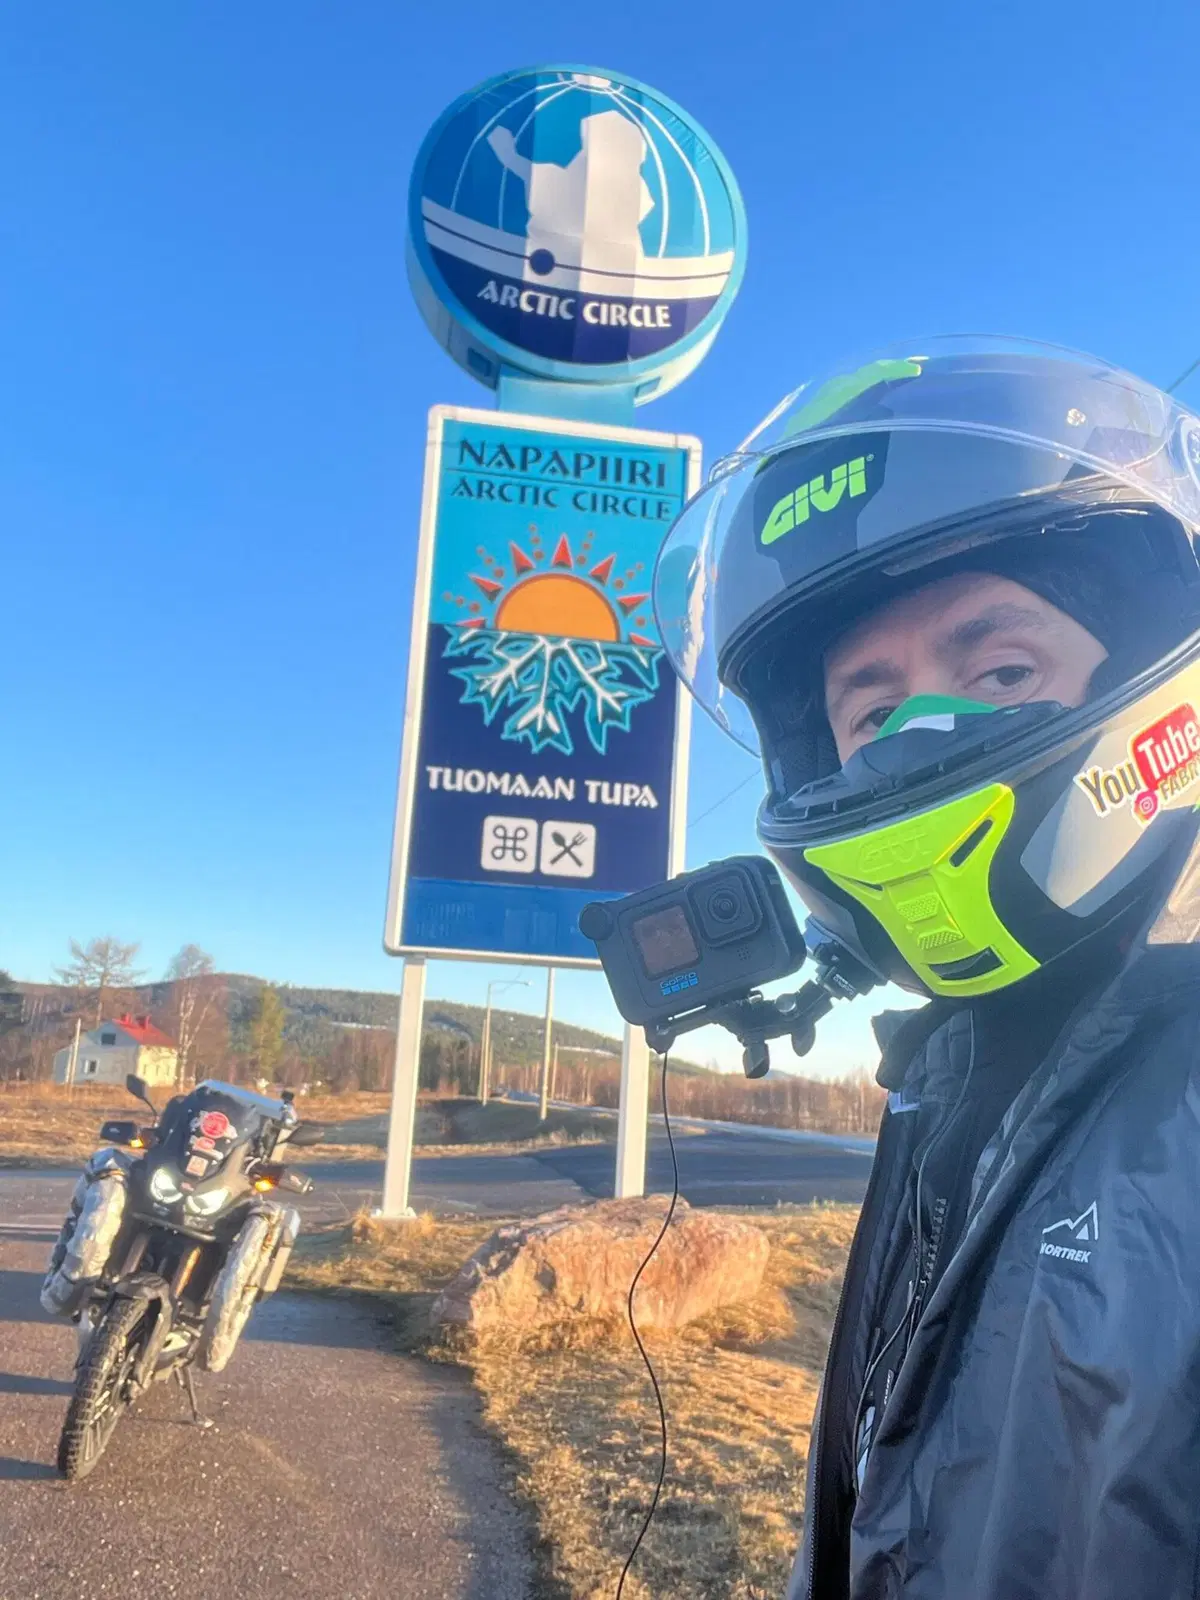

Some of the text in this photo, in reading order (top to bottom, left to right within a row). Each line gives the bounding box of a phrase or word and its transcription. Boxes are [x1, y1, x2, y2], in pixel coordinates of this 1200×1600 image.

[477, 281, 672, 327] ARCTIC CIRCLE
[459, 439, 667, 488] NAPAPIIRI
[451, 476, 671, 521] ARCTIC CIRCLE
[761, 457, 867, 545] GIVI
[426, 766, 658, 808] TUOMAAN TUPA
[660, 972, 697, 988] GoPro
